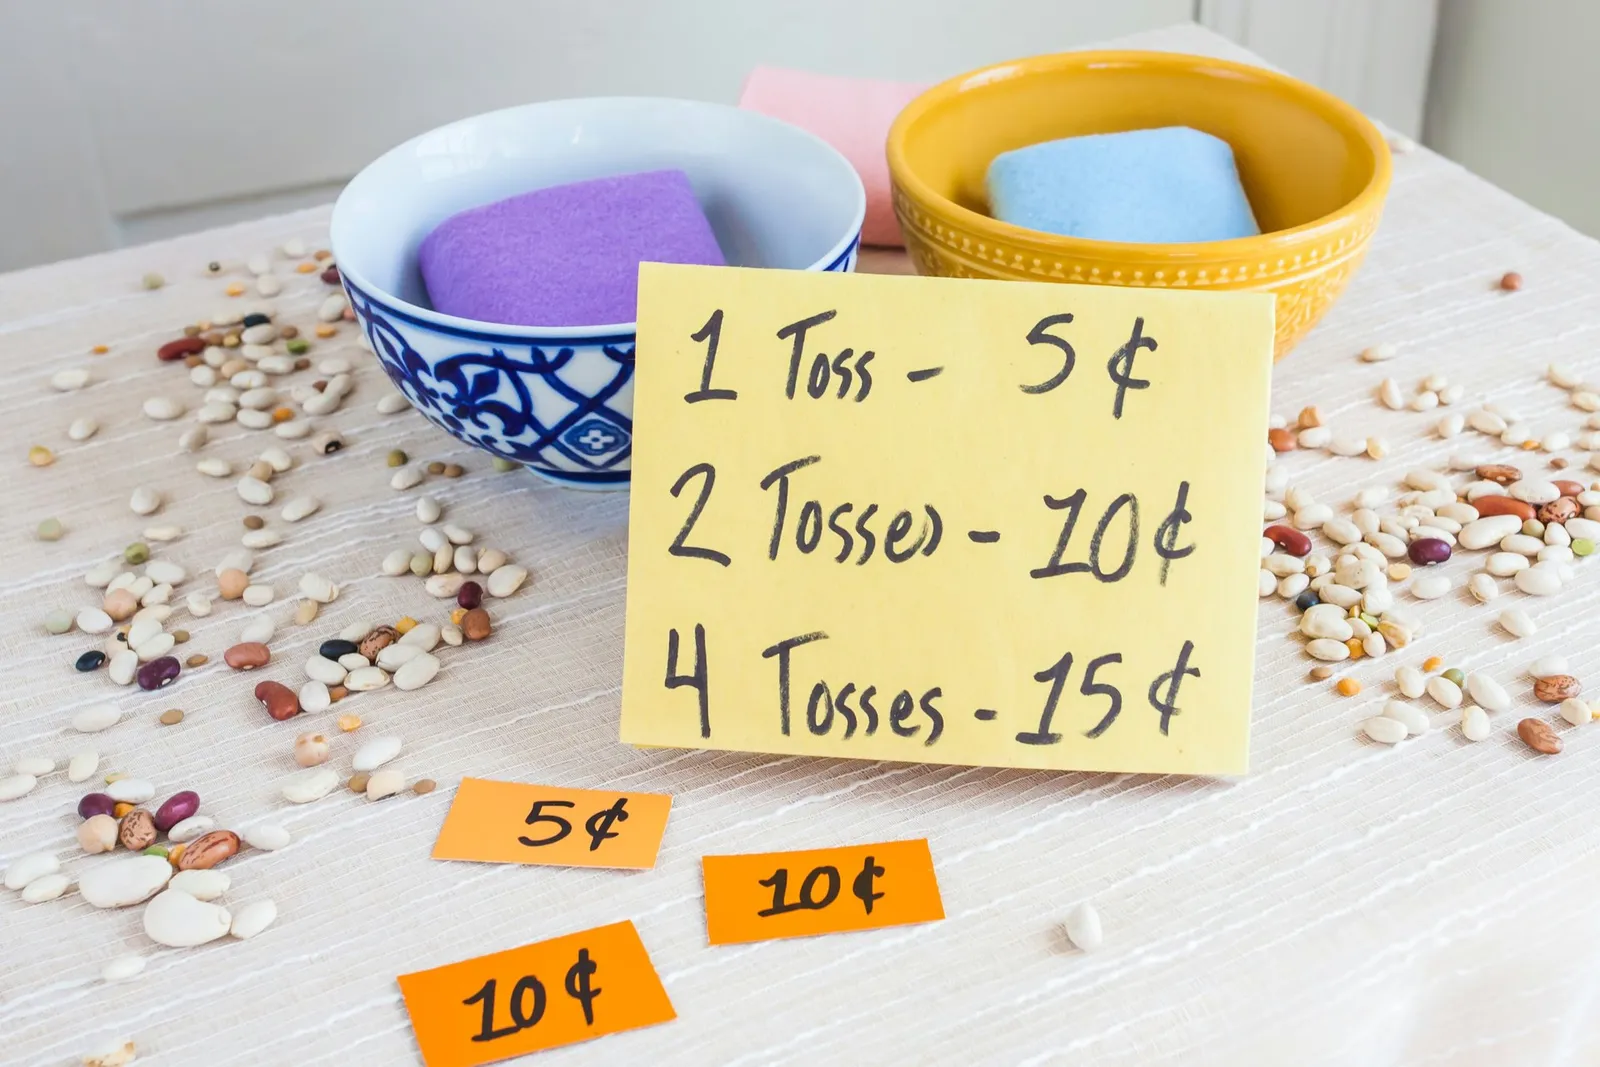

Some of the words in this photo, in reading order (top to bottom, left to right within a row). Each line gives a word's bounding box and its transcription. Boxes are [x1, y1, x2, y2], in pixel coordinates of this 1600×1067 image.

[682, 309, 738, 404] 1
[776, 309, 877, 403] Toss
[667, 462, 732, 568] 2
[759, 455, 943, 566] Tosses
[664, 622, 711, 739] 4
[762, 631, 944, 746] Tosses
[517, 798, 629, 851] 5¢
[757, 856, 886, 917] 10¢
